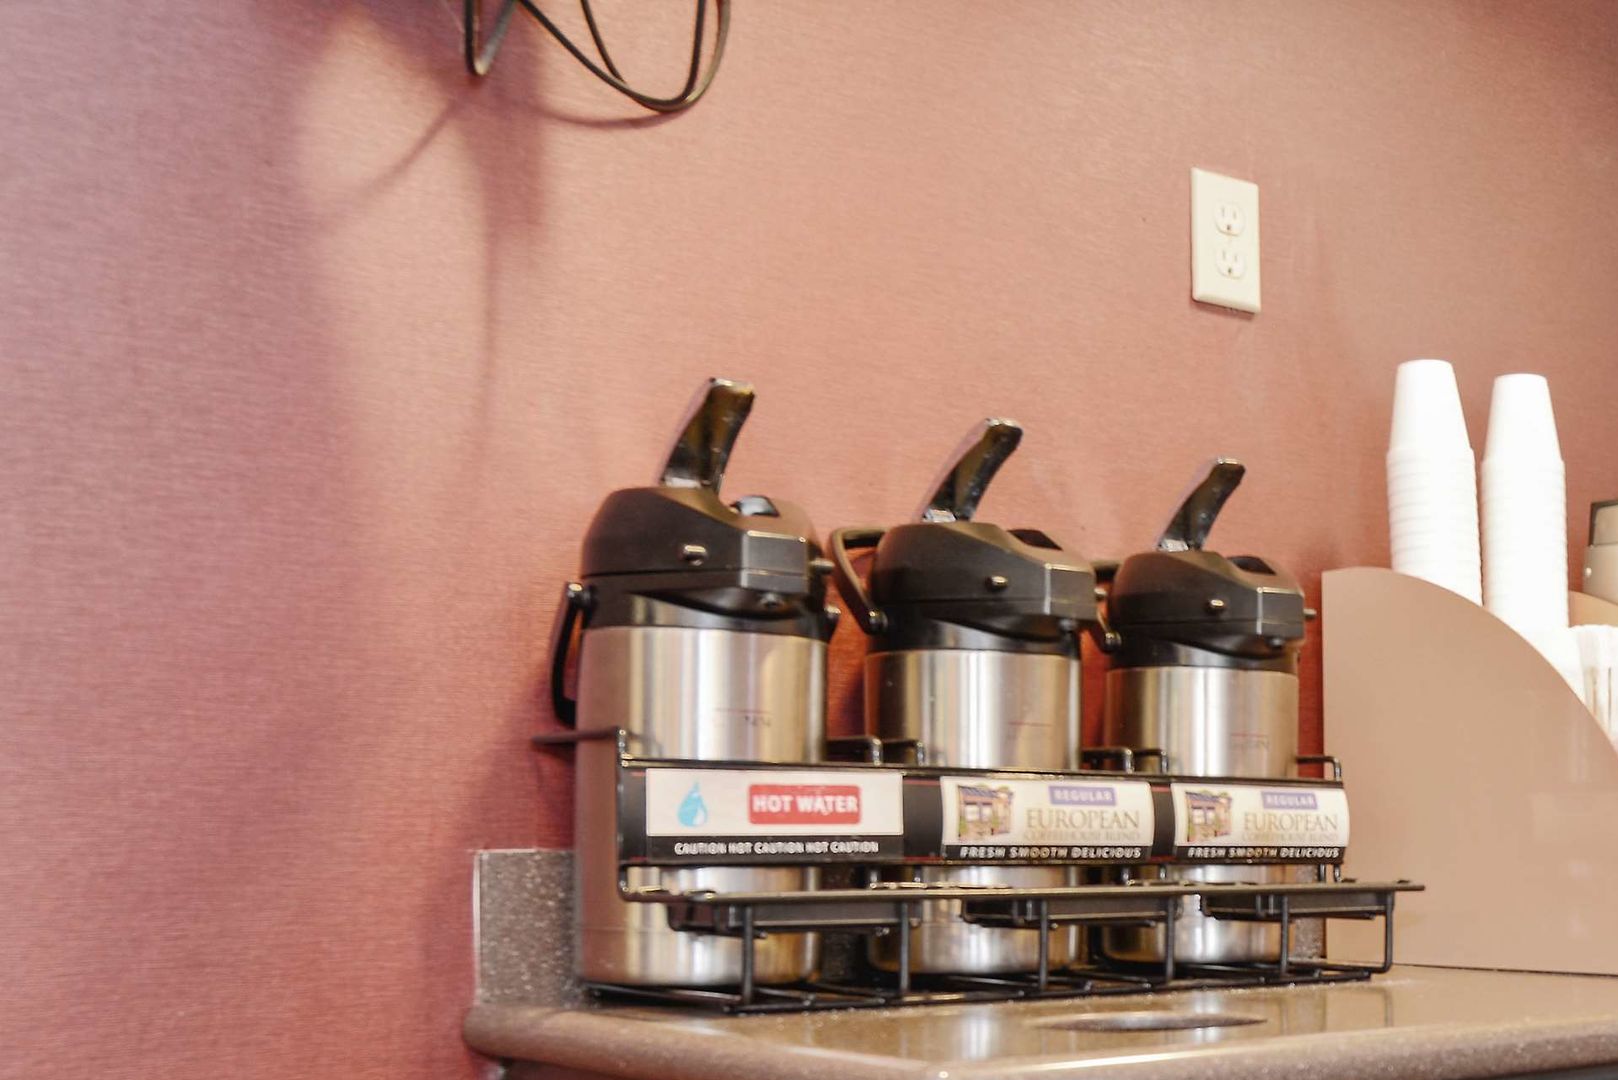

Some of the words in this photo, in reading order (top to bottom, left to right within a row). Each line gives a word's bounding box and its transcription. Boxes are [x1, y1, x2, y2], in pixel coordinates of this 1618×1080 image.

[1053, 790, 1113, 802] REGULAR
[752, 794, 794, 813] HOT
[797, 794, 859, 815] WATER
[1026, 809, 1140, 830] EUROPEAN
[1243, 812, 1339, 832] EUROPEAN
[674, 842, 727, 855] CAUTION
[728, 842, 753, 854] HOT
[754, 842, 804, 855] CAUTION
[804, 842, 829, 854] HOT
[830, 841, 879, 854] CAUTION
[959, 847, 1006, 859] FRESH
[1009, 847, 1068, 859] SMOOTH
[1071, 847, 1142, 859] DELICIOUS
[1187, 847, 1226, 858] FRESH
[1228, 847, 1278, 858] SMOOTH
[1280, 848, 1340, 858] DELICIOUS
